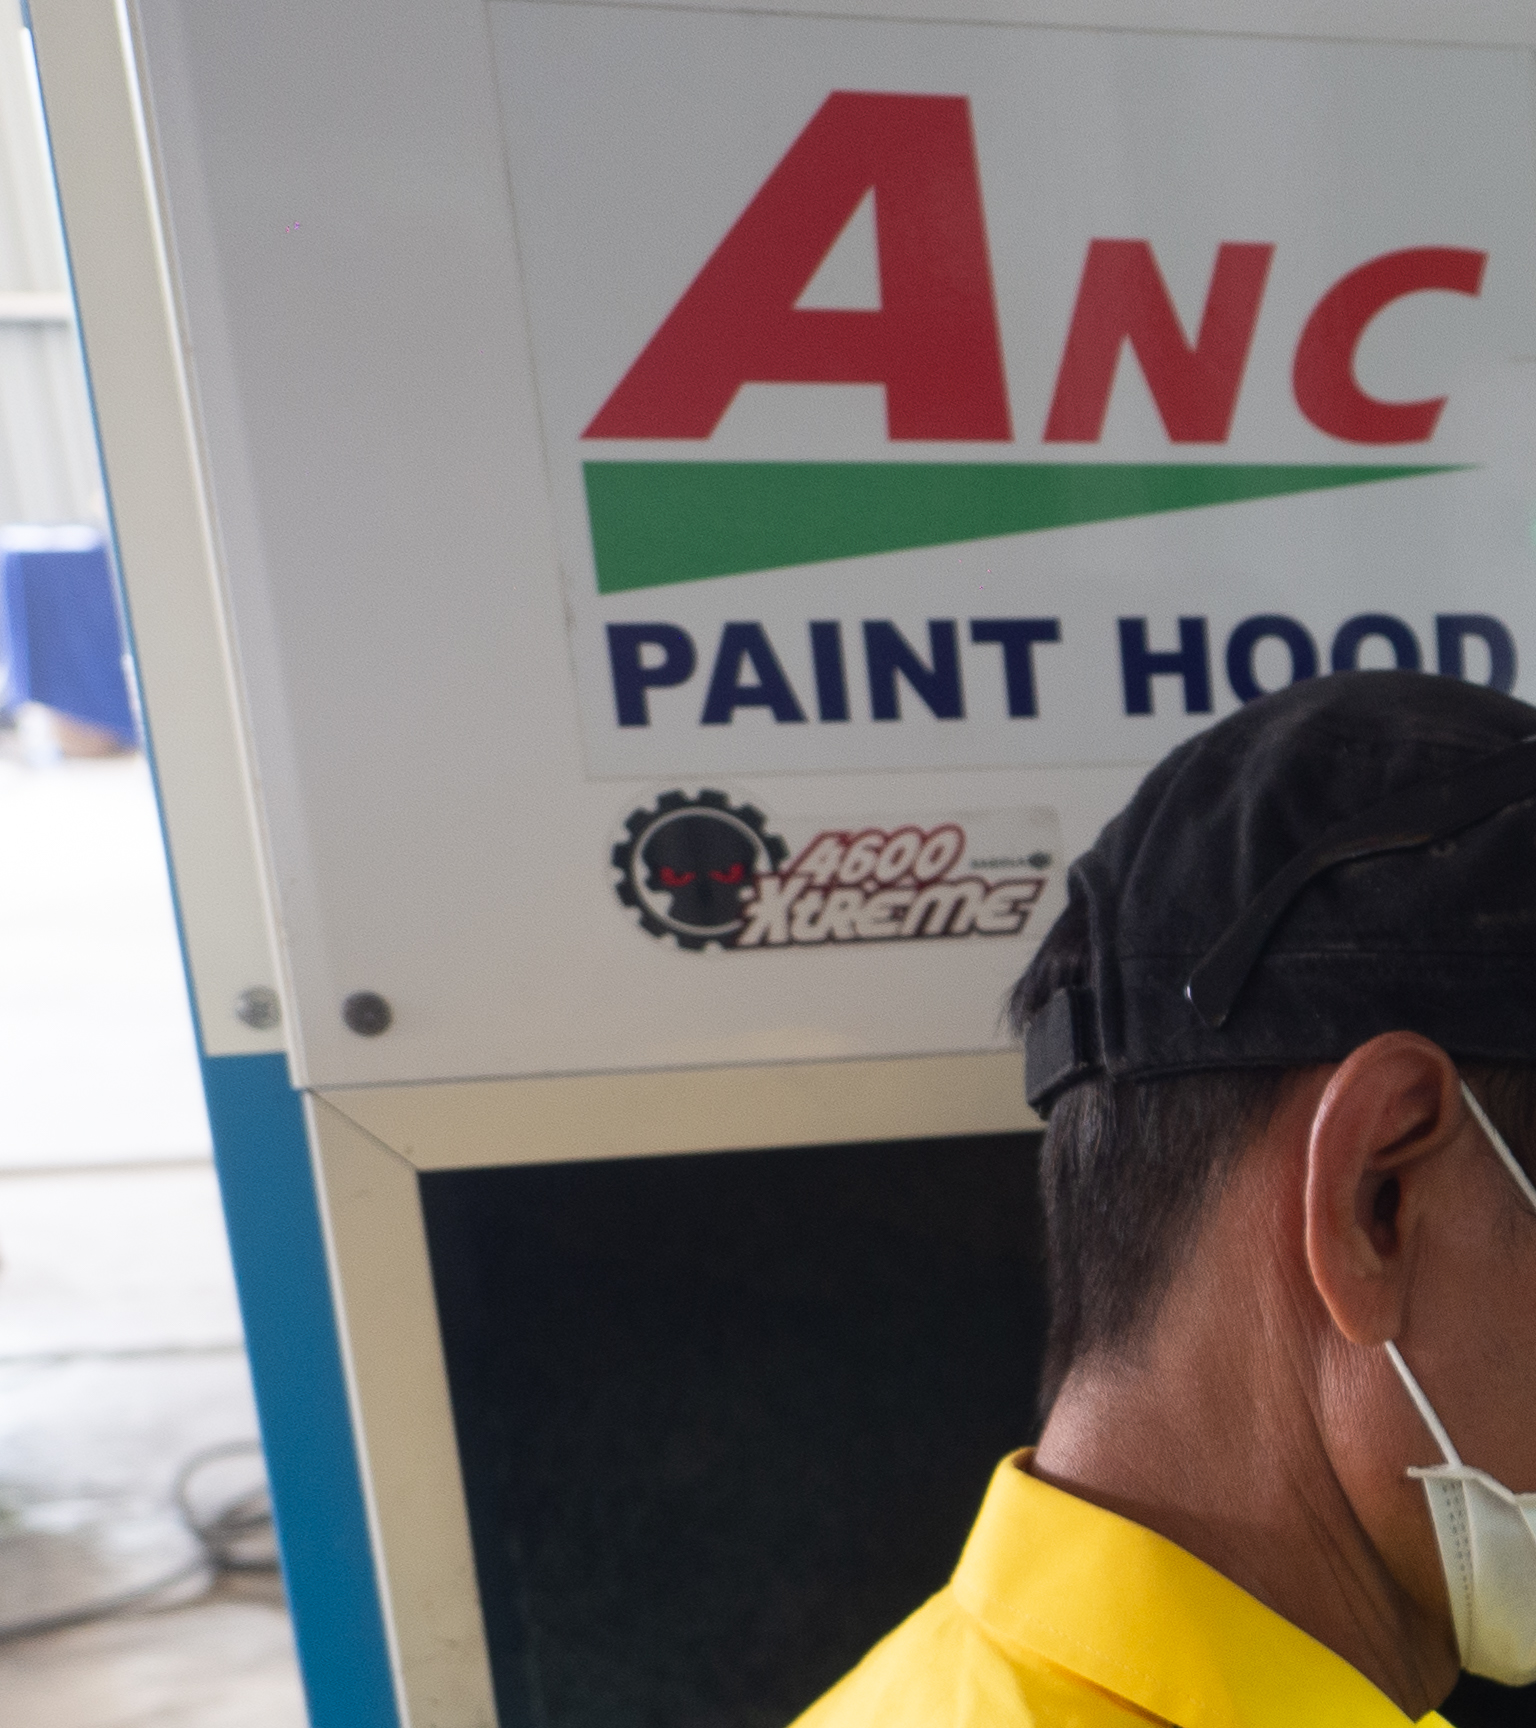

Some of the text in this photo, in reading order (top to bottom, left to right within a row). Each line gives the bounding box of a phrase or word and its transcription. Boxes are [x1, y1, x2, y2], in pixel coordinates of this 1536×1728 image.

[581, 90, 1487, 445] ANC
[605, 612, 1518, 727] PAINT HOOD
[793, 822, 966, 885] 4600
